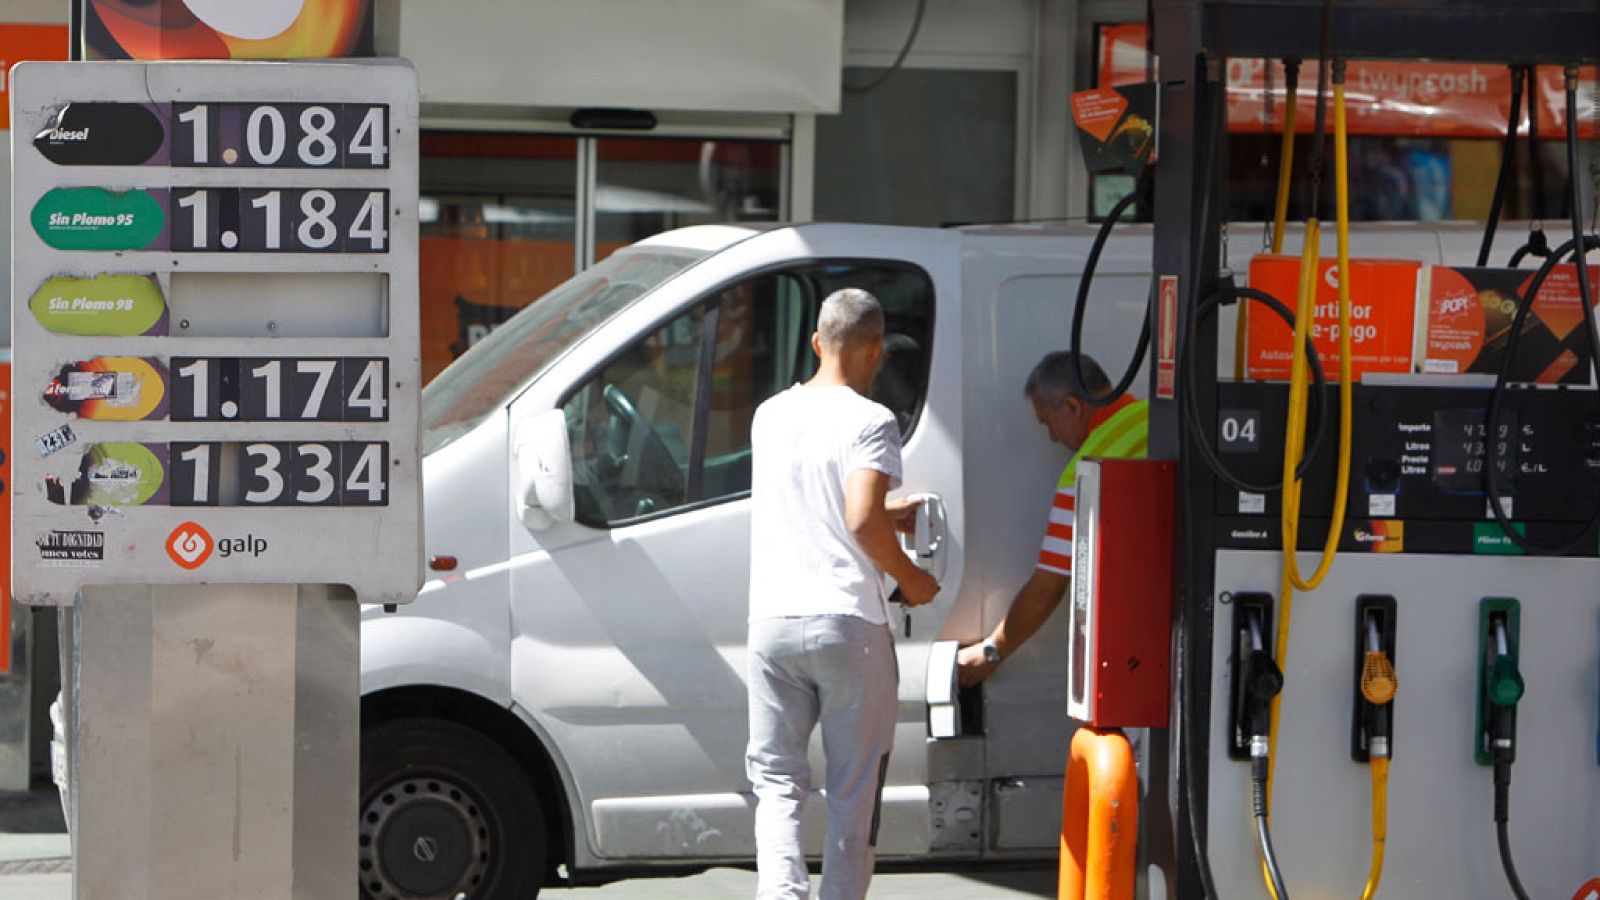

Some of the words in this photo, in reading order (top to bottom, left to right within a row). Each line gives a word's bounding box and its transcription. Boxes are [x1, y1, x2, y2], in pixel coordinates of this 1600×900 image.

[48, 127, 89, 142] Diesel
[48, 213, 69, 226] Sin
[72, 213, 115, 226] Plomo
[116, 213, 134, 226] 95
[178, 190, 388, 249] 1.184
[48, 298, 69, 311] Sin
[72, 298, 115, 311] Plomo
[117, 298, 134, 311] 98
[179, 359, 387, 418] 1.174
[1221, 417, 1257, 443] 04
[217, 534, 268, 557] galp
